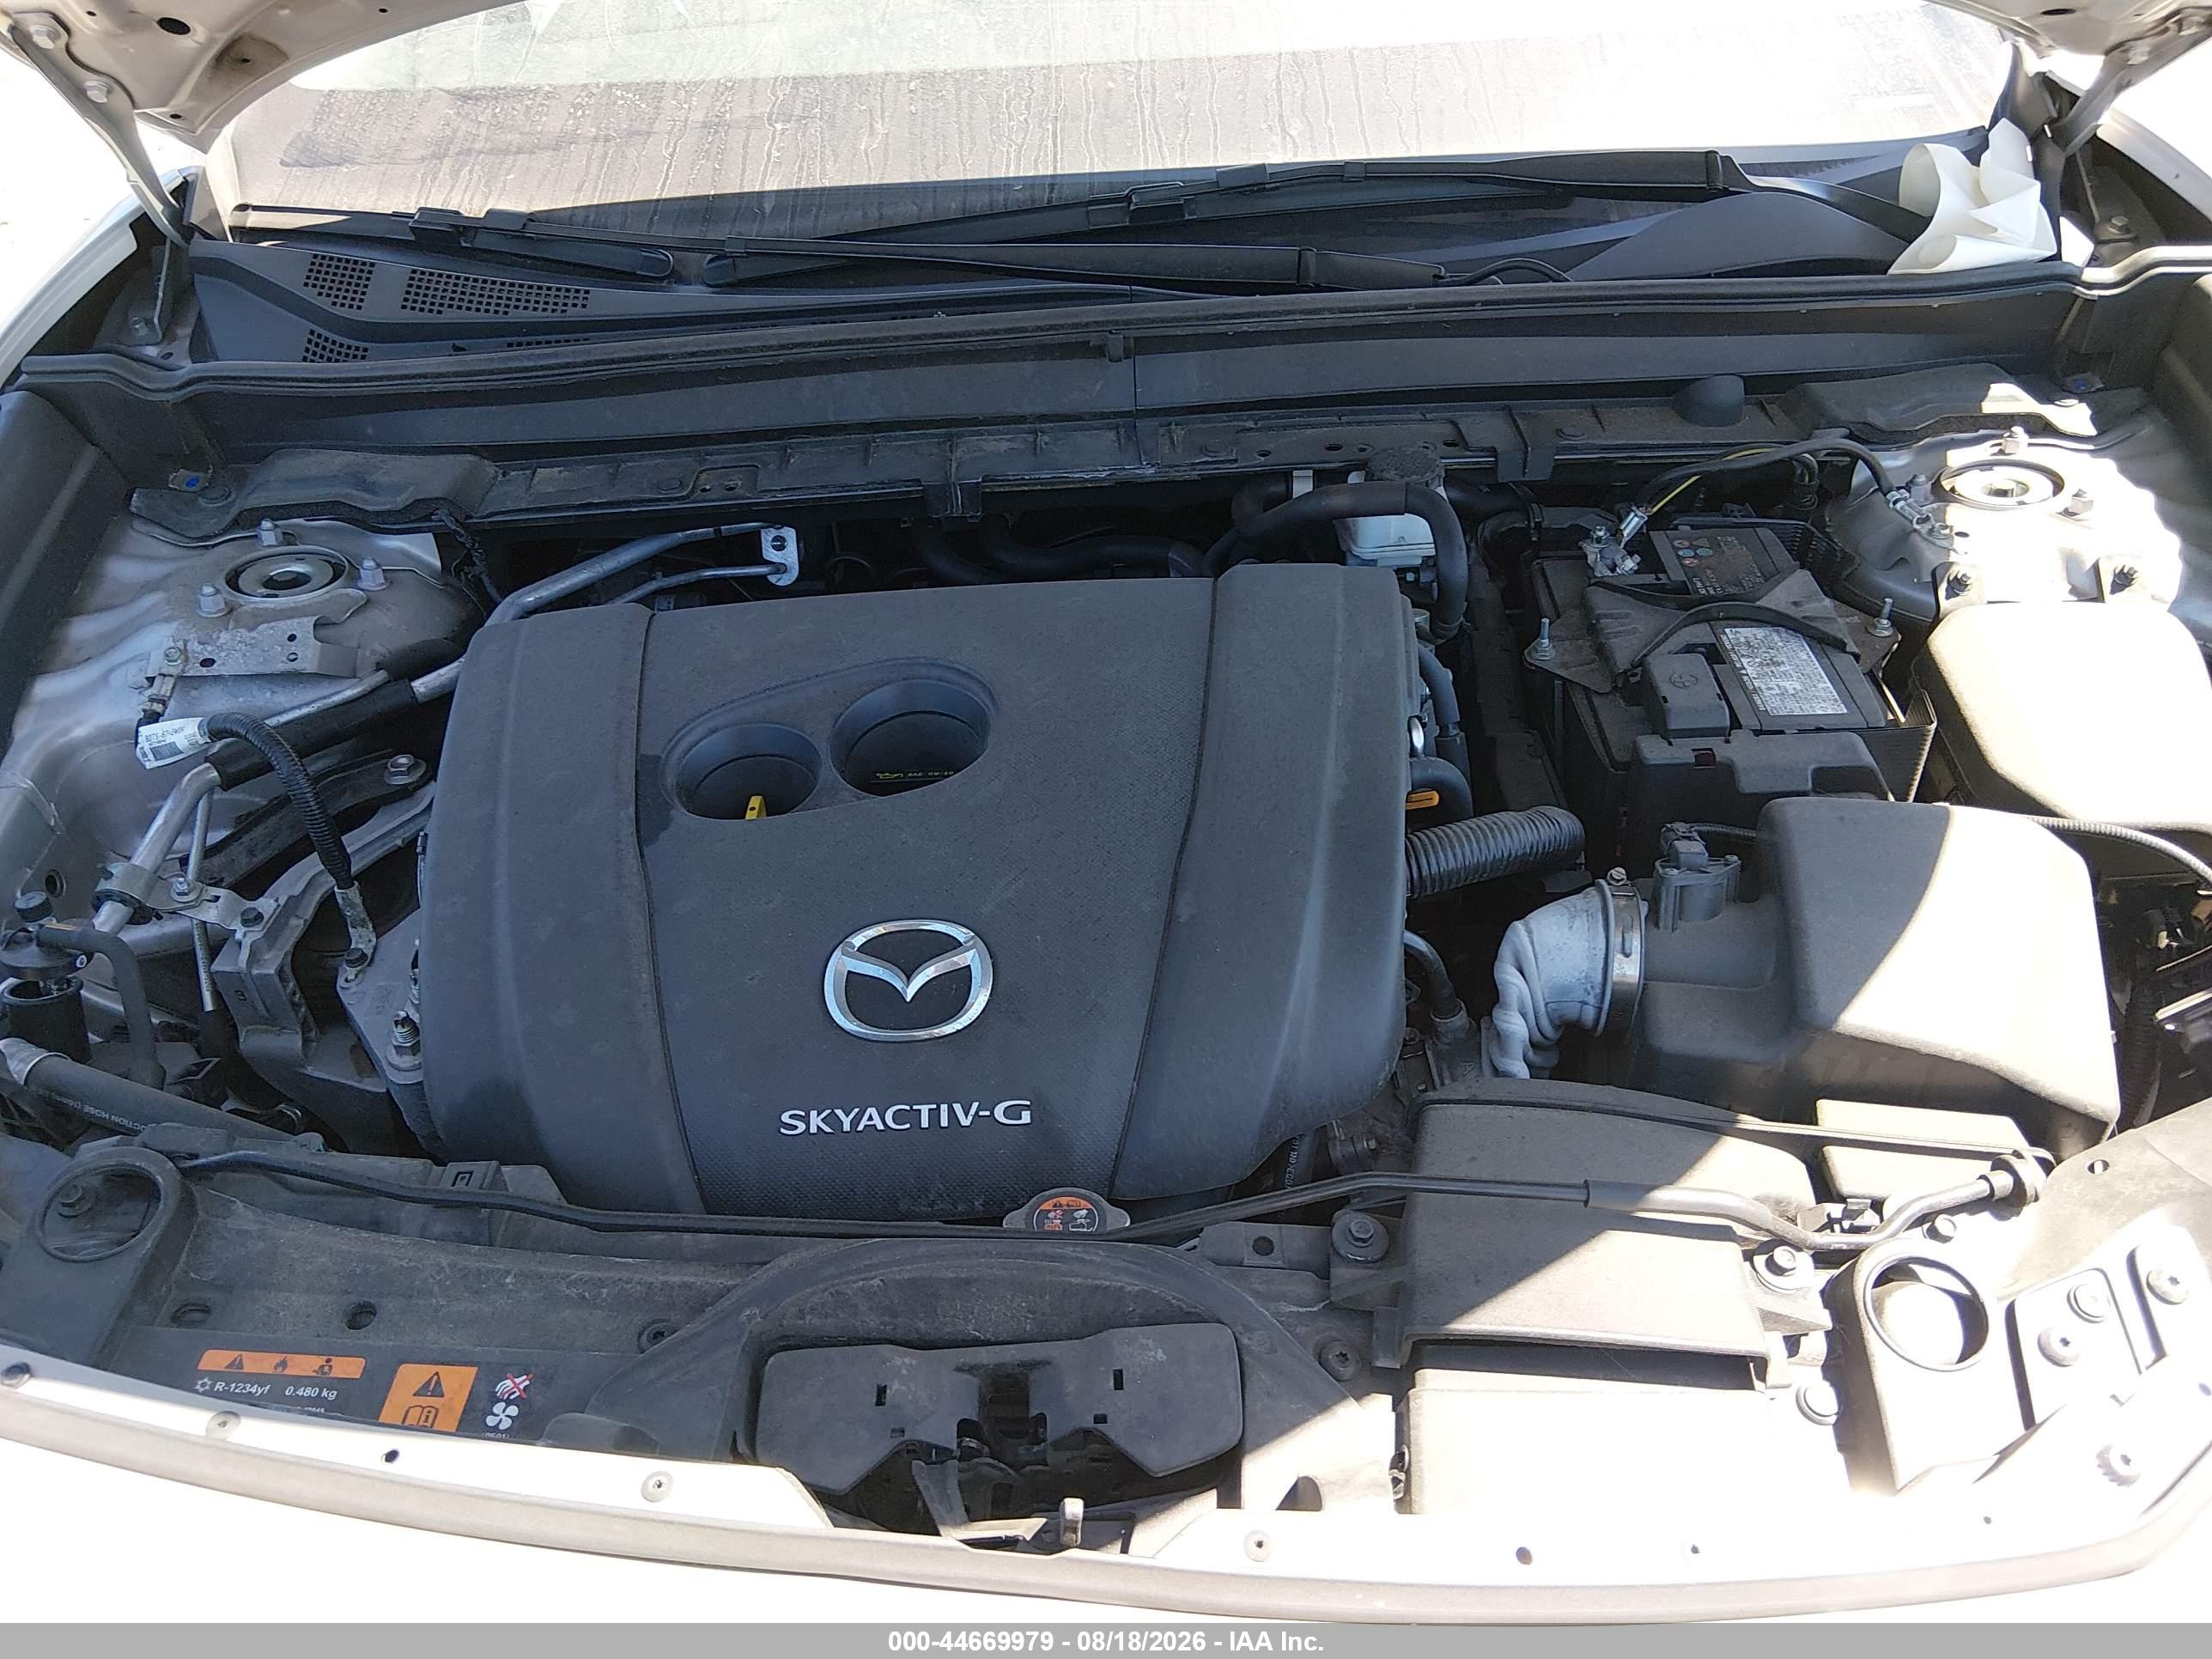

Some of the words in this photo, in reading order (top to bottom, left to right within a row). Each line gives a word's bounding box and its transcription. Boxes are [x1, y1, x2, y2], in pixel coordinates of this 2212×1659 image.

[83, 1103, 110, 1120] HOSE
[779, 1100, 1031, 1135] SKYACTIV-G
[111, 1115, 148, 1132] UCTION
[214, 1381, 270, 1396] R-1234yf
[284, 1386, 319, 1397] 0.480
[321, 1388, 338, 1401] kg
